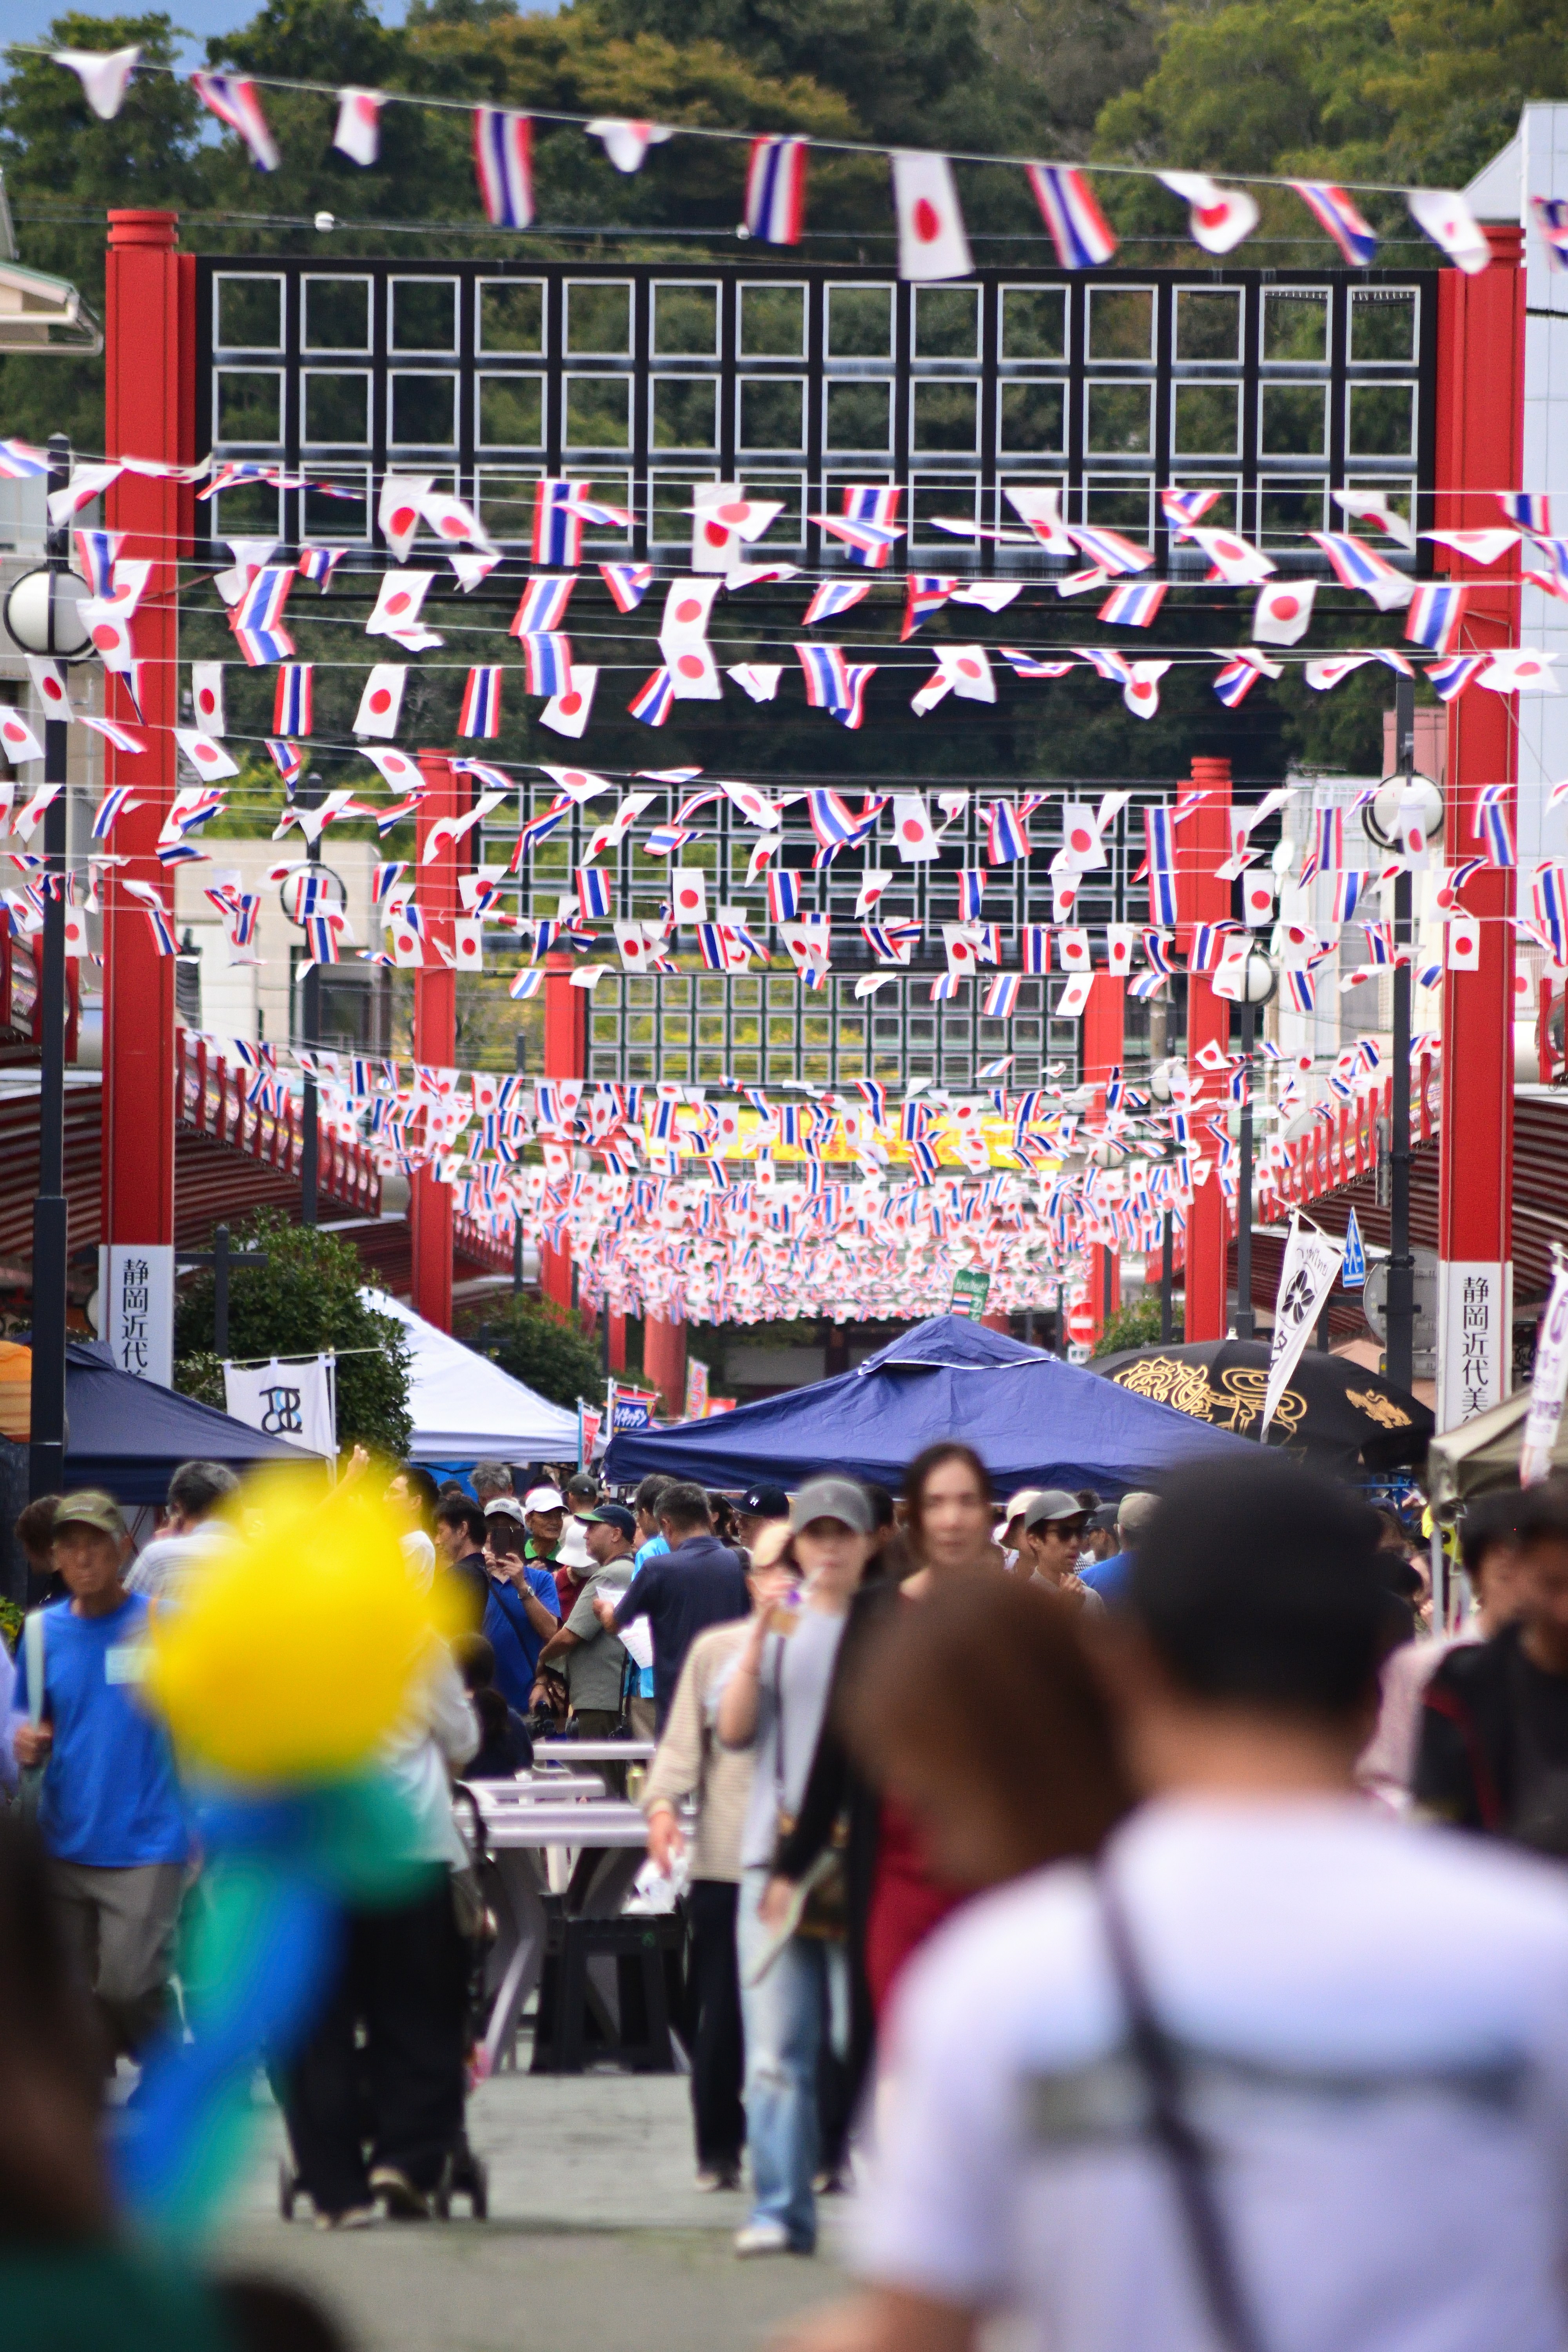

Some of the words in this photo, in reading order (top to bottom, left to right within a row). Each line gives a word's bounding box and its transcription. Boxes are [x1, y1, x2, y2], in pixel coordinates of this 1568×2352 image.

[122, 1259, 148, 1375] 静岡近代
[1462, 1277, 1489, 1423] 静岡近代美
[750, 1497, 759, 1506] H
